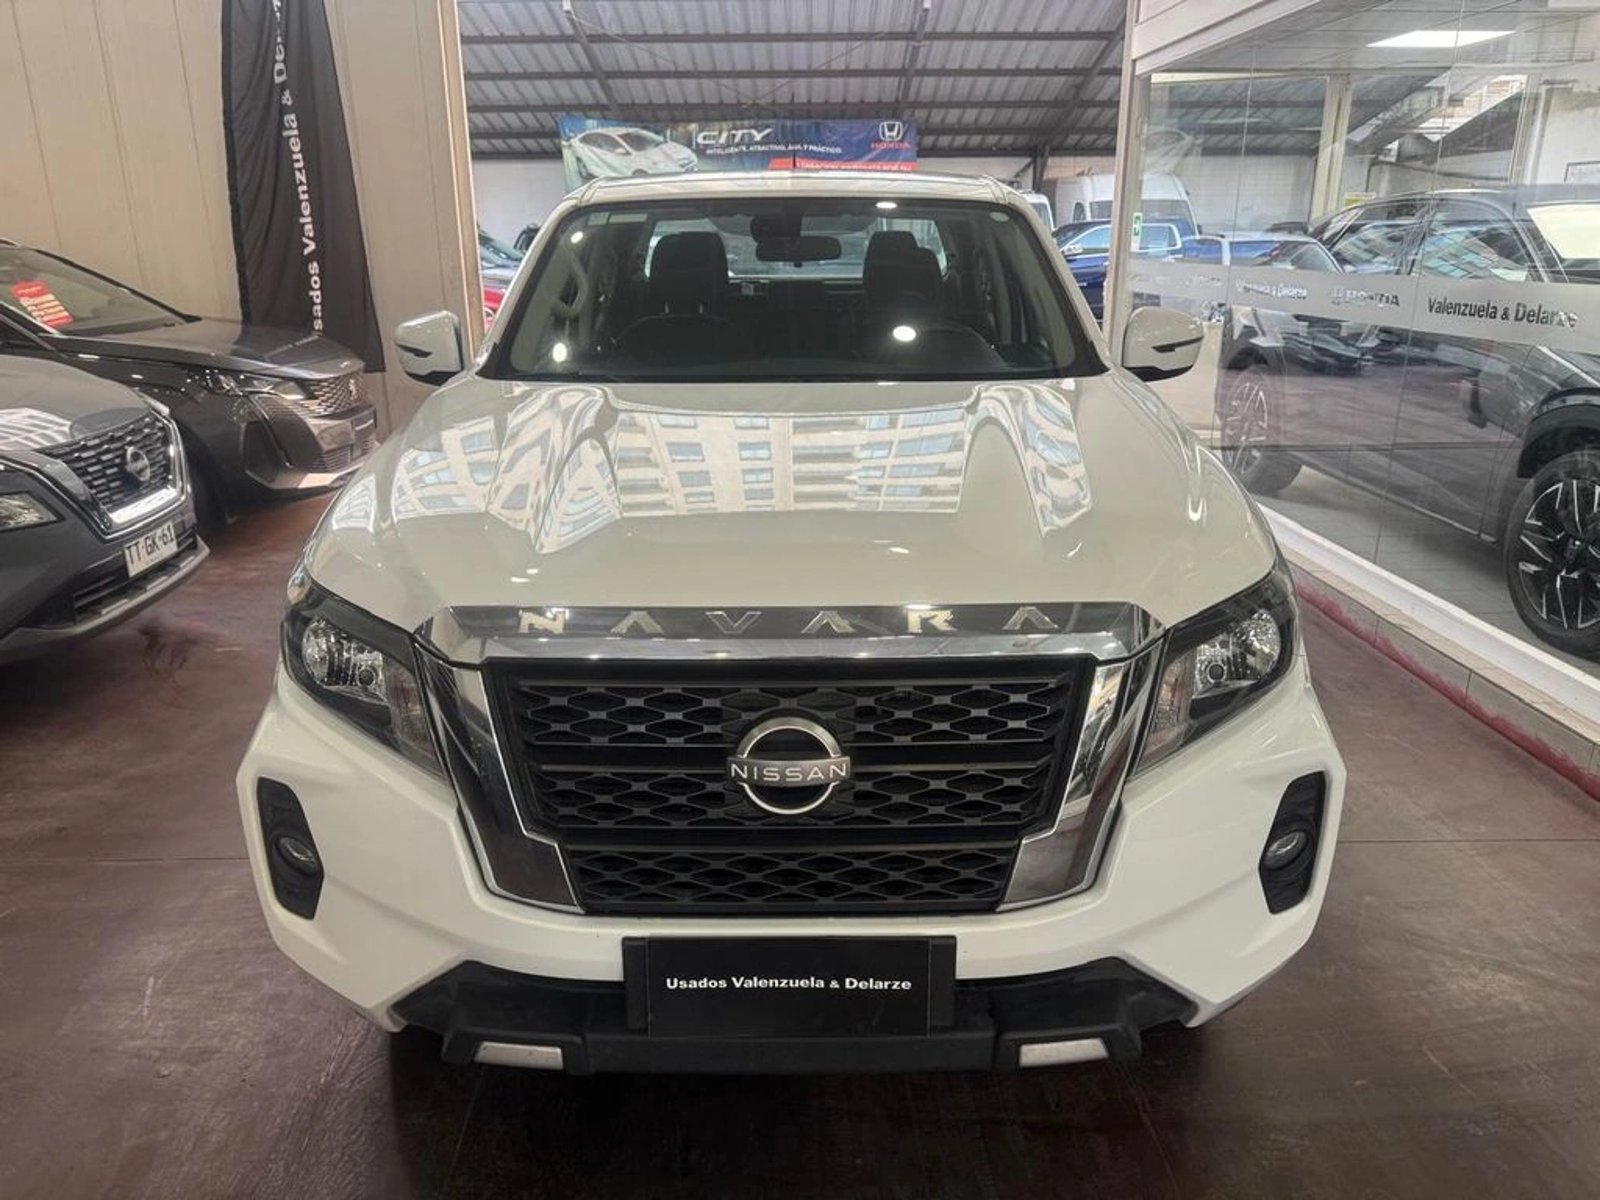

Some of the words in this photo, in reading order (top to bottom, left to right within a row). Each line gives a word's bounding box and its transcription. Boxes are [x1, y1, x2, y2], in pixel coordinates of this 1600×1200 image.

[281, 89, 293, 107] &
[697, 128, 773, 144] CITY
[282, 113, 316, 256] Valenzuela
[308, 260, 323, 336] sados
[1427, 297, 1497, 320] Valenzuela
[1500, 306, 1510, 321] &
[518, 605, 1058, 635] NAVARA
[730, 763, 846, 782] NISSAN
[666, 977, 728, 990] Usados
[731, 976, 825, 989] Valenzuela
[829, 980, 840, 989] &
[845, 977, 912, 990] Delarze
